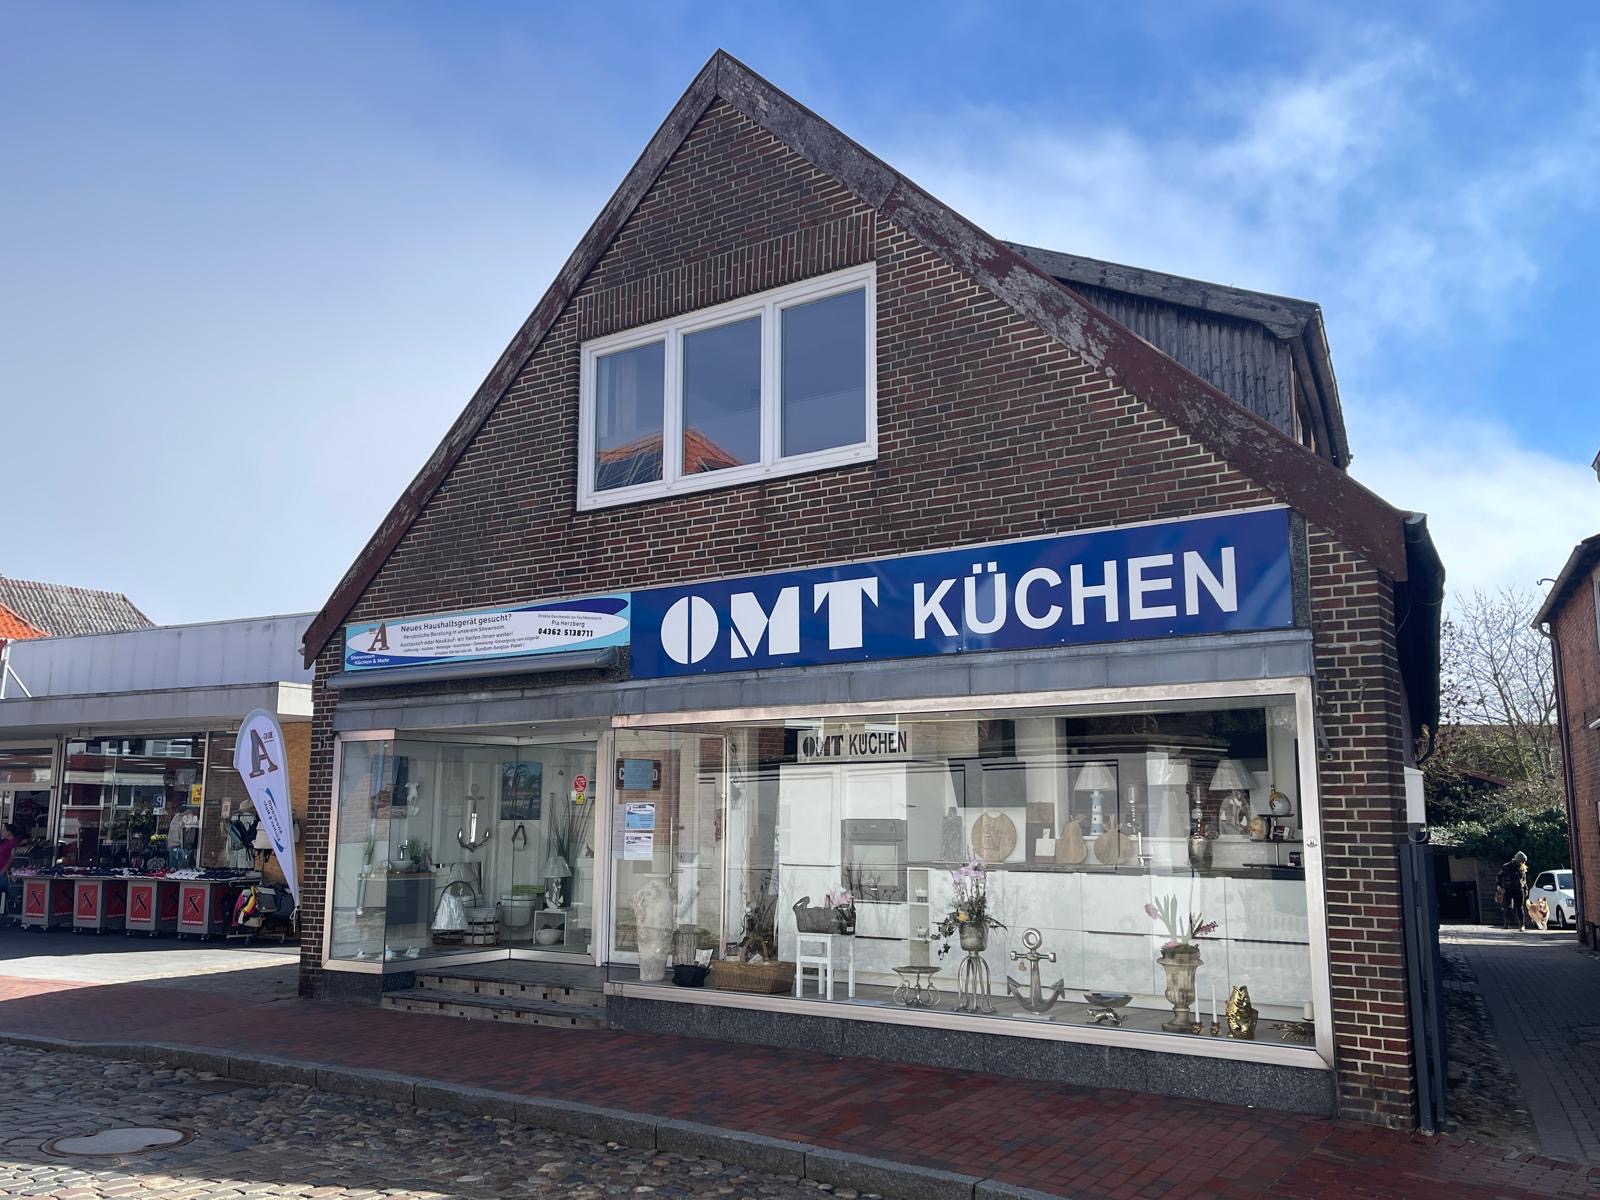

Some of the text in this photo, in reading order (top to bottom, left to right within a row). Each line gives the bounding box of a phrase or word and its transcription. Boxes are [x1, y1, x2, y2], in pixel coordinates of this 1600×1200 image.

[661, 546, 1238, 664] OMT KÜCHEN
[400, 613, 512, 633] Neues Haushaltsgerät gesucht?
[560, 620, 586, 628] Herzberg
[403, 632, 430, 640] Persönliche
[538, 627, 594, 637] 04362 5138711
